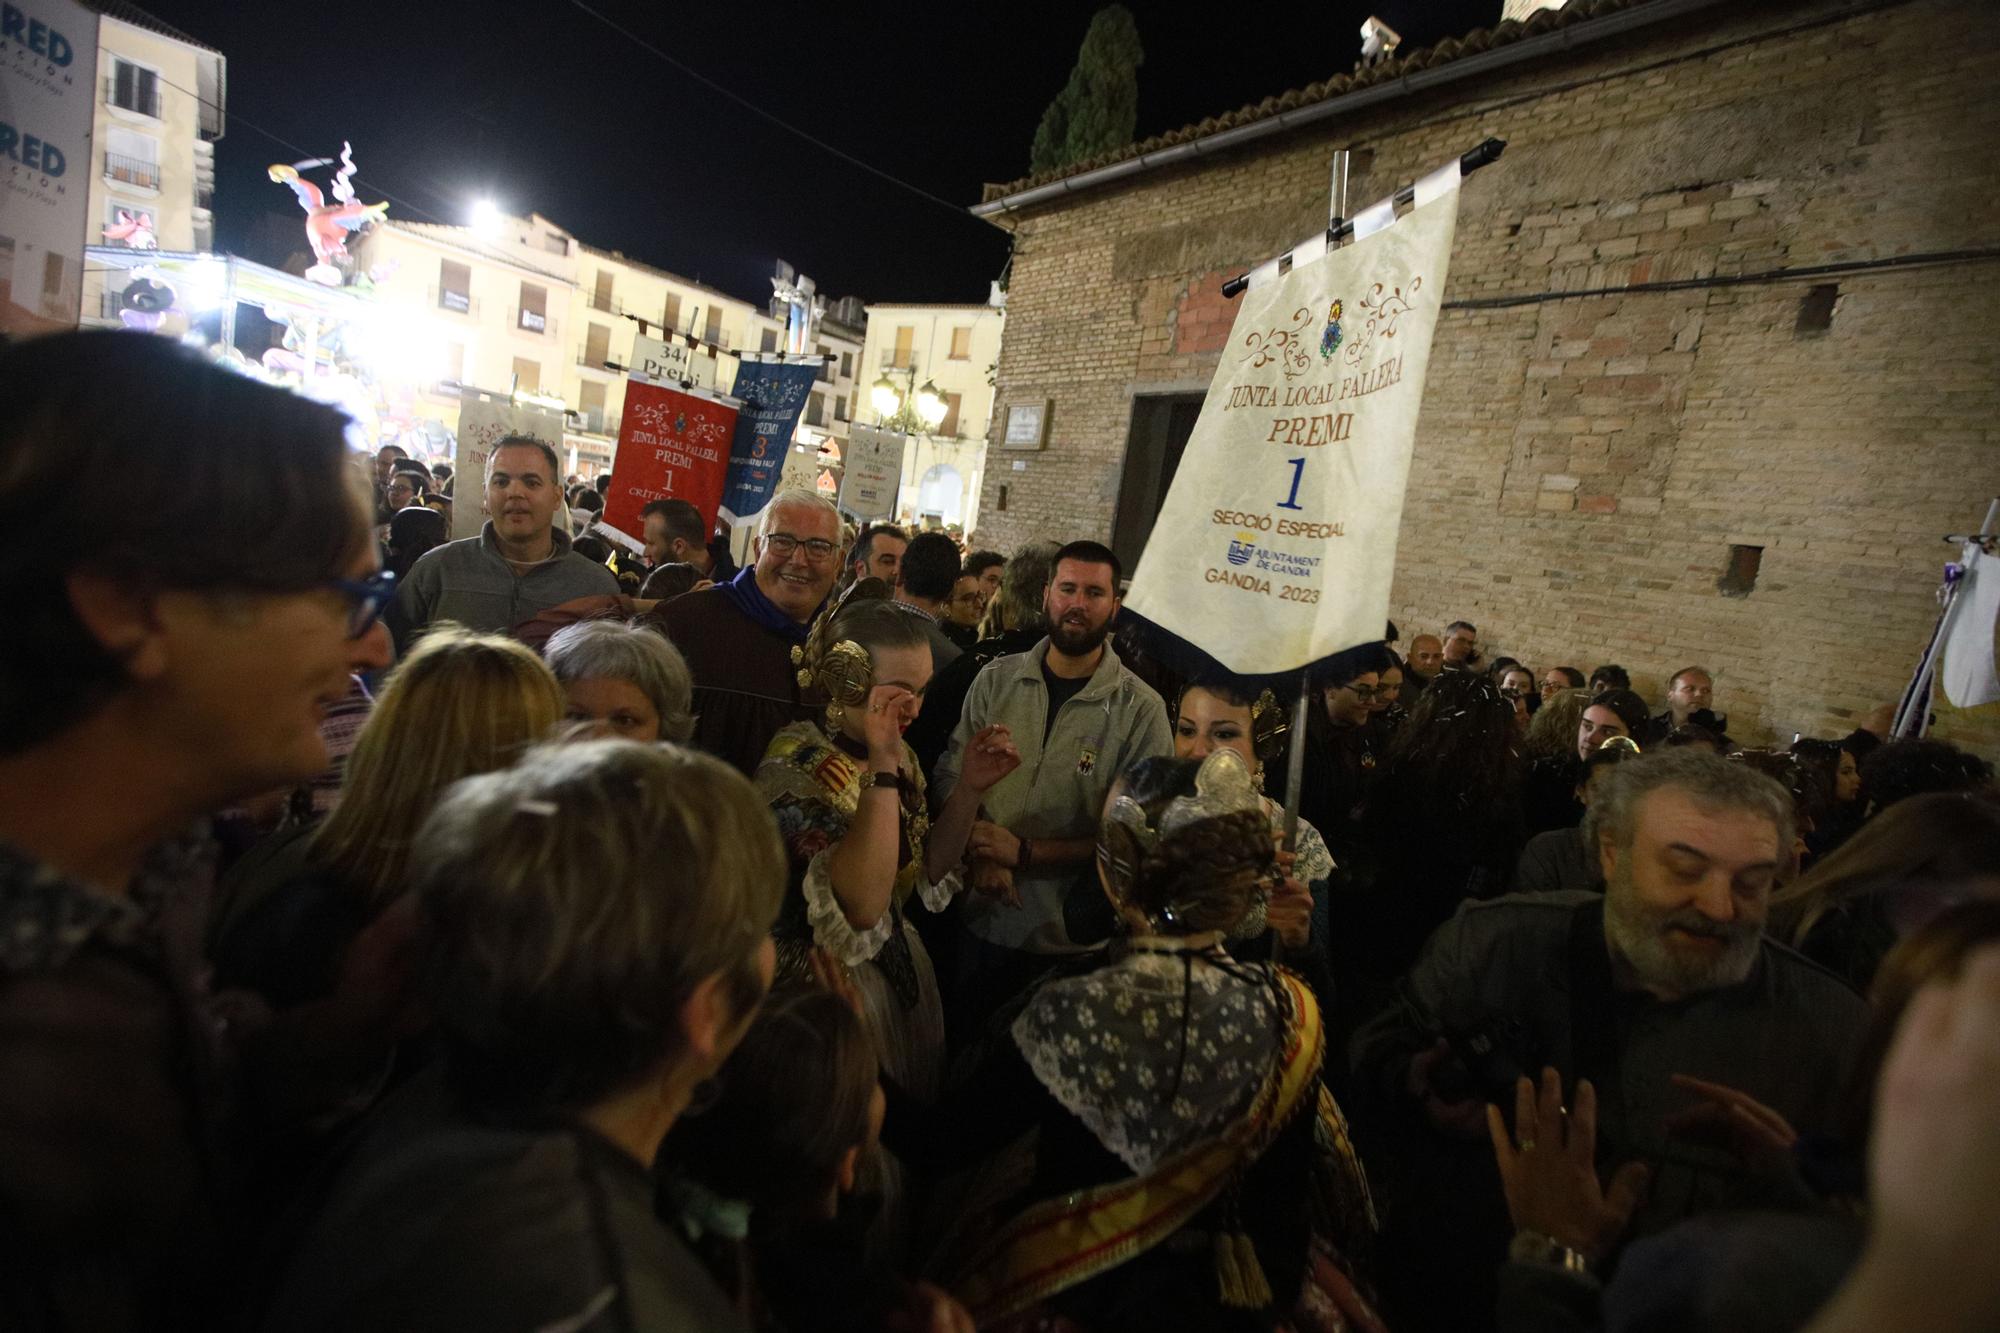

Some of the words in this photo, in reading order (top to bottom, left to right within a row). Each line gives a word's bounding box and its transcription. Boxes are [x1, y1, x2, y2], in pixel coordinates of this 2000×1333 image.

[1224, 385, 1280, 411] JUNTA
[1283, 383, 1337, 407] LOCAL
[1340, 352, 1404, 400] FALLERA
[754, 422, 779, 435] PREMI
[1266, 413, 1355, 447] PREMI
[469, 450, 488, 465] JUNT
[631, 430, 657, 445] JUNTA
[659, 437, 684, 452] LOCAL
[685, 443, 718, 462] FALLERA
[752, 435, 768, 458] 3
[655, 448, 692, 469] PREMI
[662, 470, 674, 492] 1
[1276, 457, 1306, 511] 1
[1212, 509, 1273, 532] SECCIÓ
[1276, 519, 1345, 539] ESPECIAL
[1255, 549, 1321, 568] AJUNTAMENT
[1256, 559, 1270, 571] DE
[1271, 564, 1311, 577] GANDIA
[1204, 567, 1271, 595] GANDIA
[1278, 585, 1321, 604] 2023
